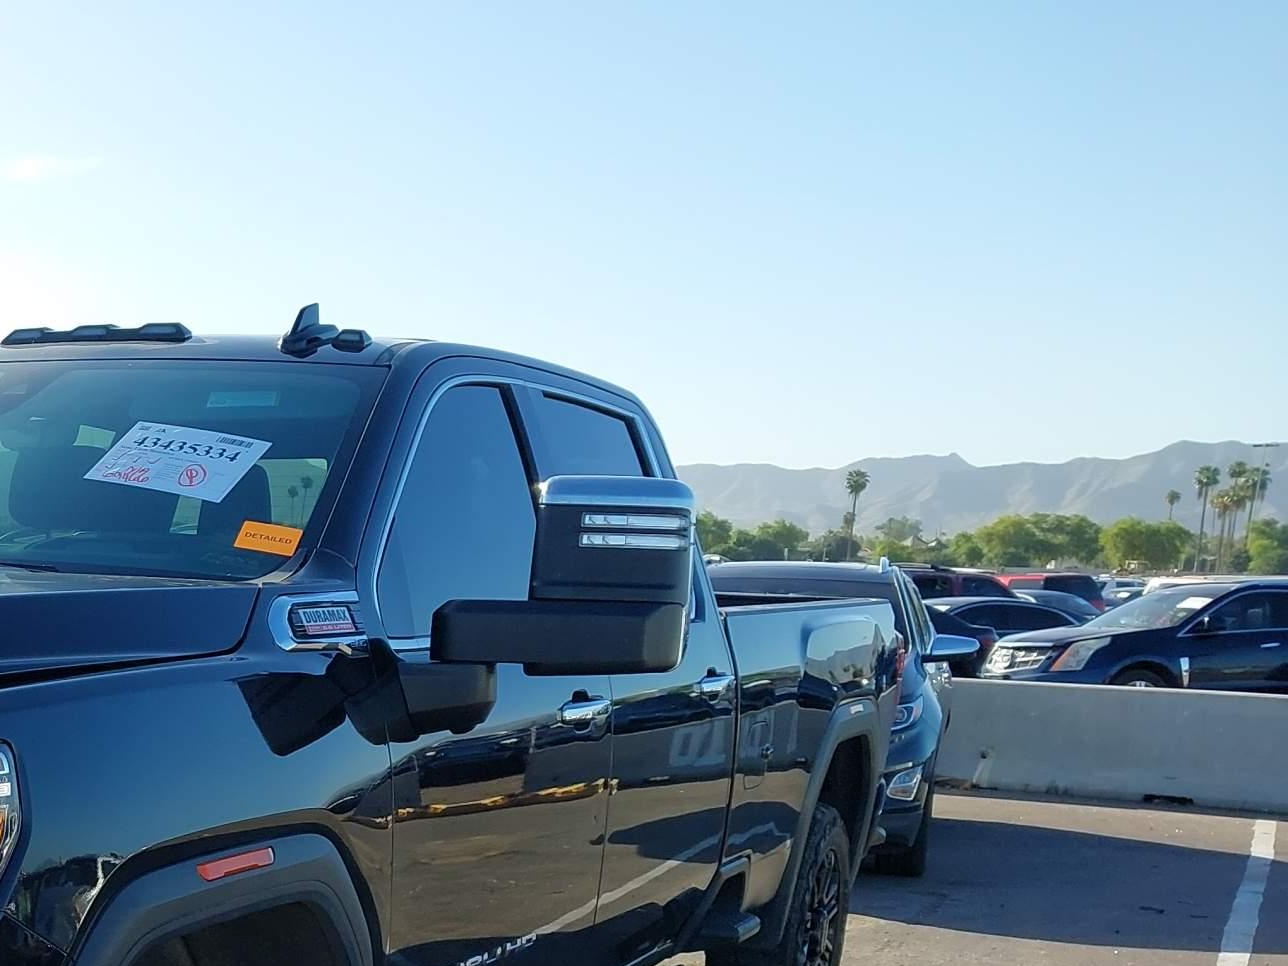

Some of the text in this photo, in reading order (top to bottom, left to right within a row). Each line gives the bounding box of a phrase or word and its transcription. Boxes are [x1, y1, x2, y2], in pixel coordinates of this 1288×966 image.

[133, 435, 240, 462] 43435334
[244, 531, 292, 545] DETAILED
[302, 609, 349, 624] DURAMAX
